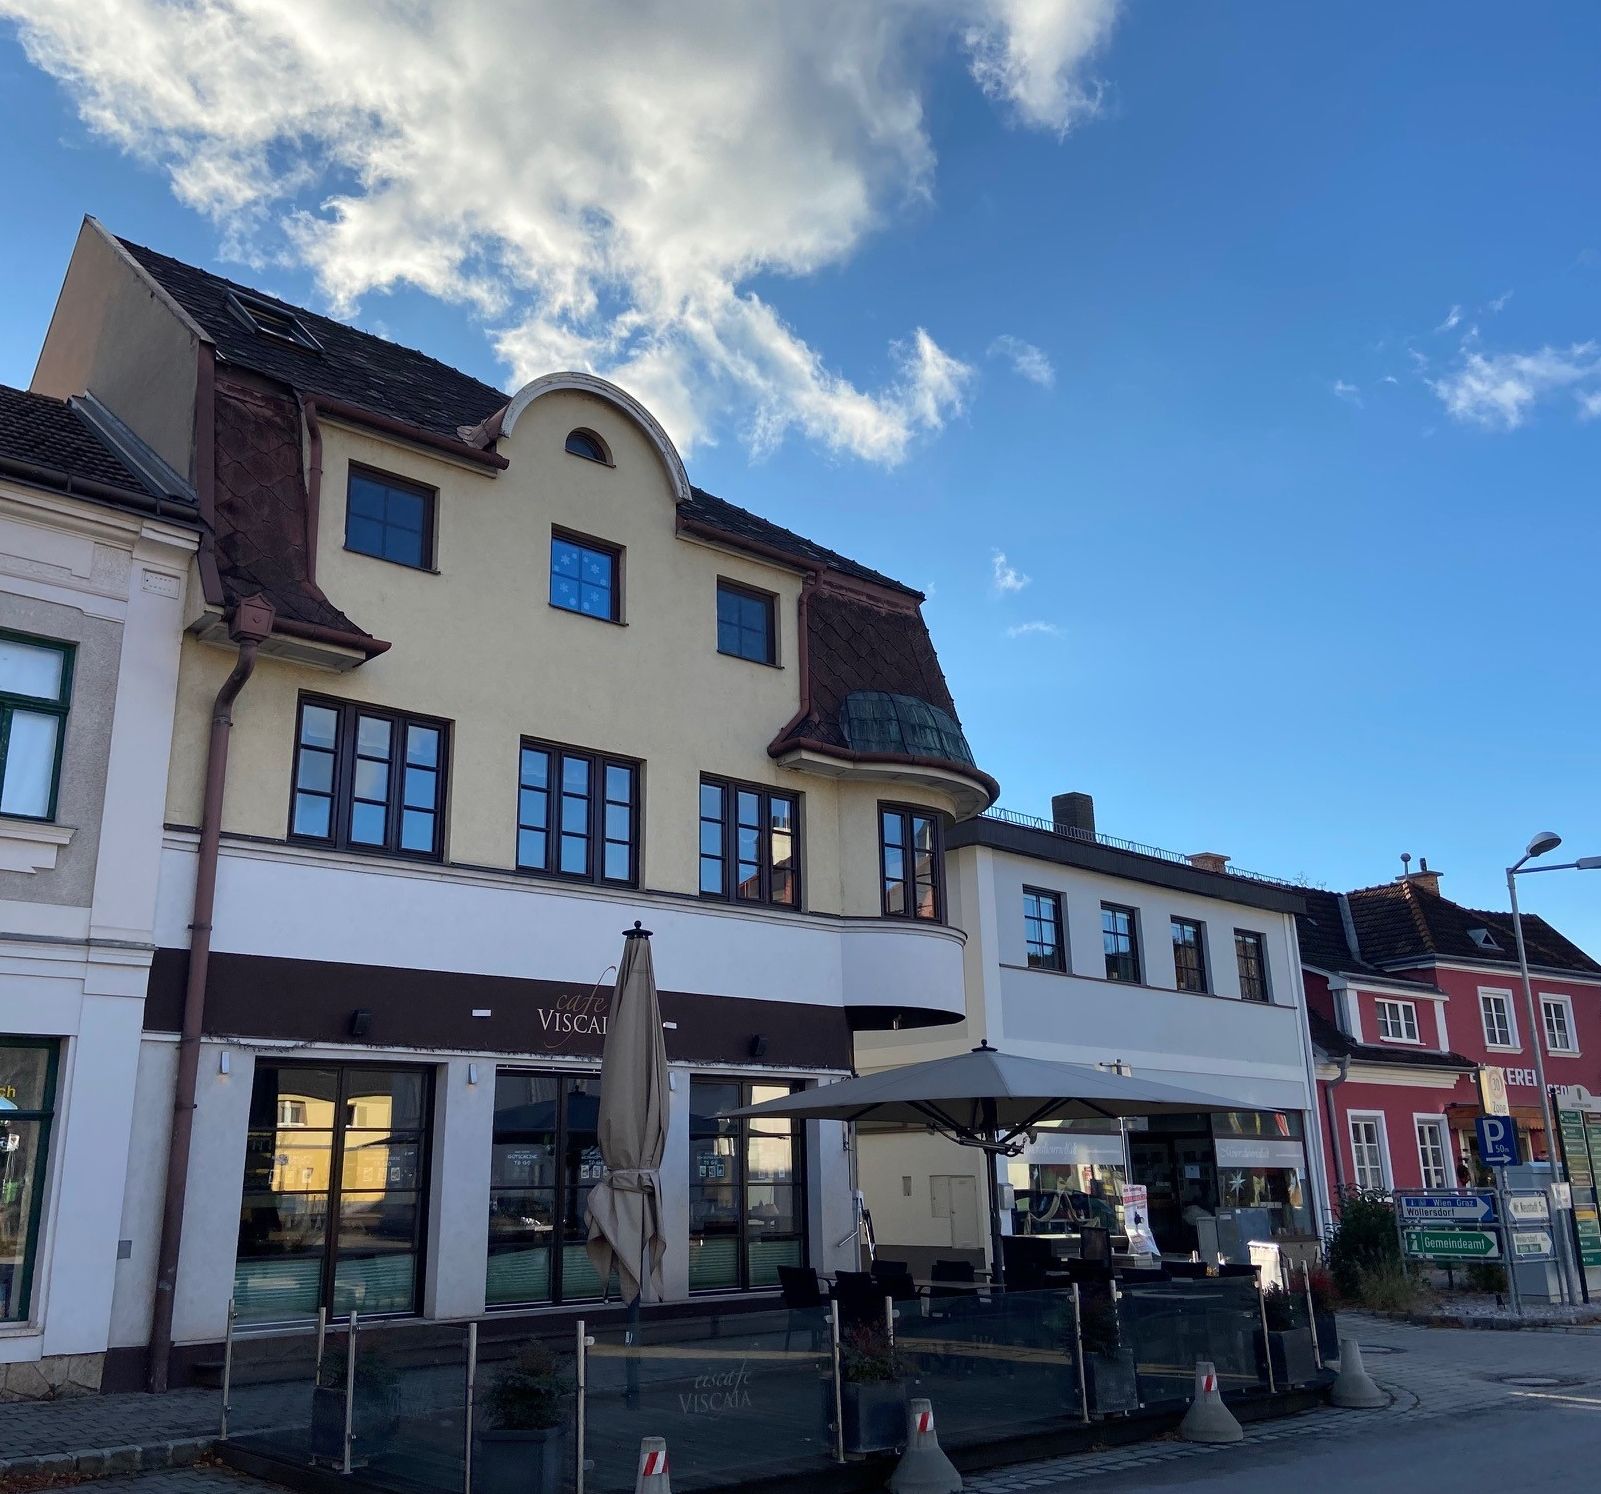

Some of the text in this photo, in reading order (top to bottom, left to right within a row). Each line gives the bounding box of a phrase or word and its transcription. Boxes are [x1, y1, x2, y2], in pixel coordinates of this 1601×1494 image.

[537, 1008, 608, 1035] VISCAI
[1492, 1101, 1507, 1114] Zone
[1482, 1119, 1504, 1154] P
[1433, 1199, 1452, 1207] Wien
[1456, 1199, 1474, 1207] Graz
[1406, 1207, 1455, 1217] Wollersdorf
[1424, 1236, 1485, 1250] Gemeindeamt
